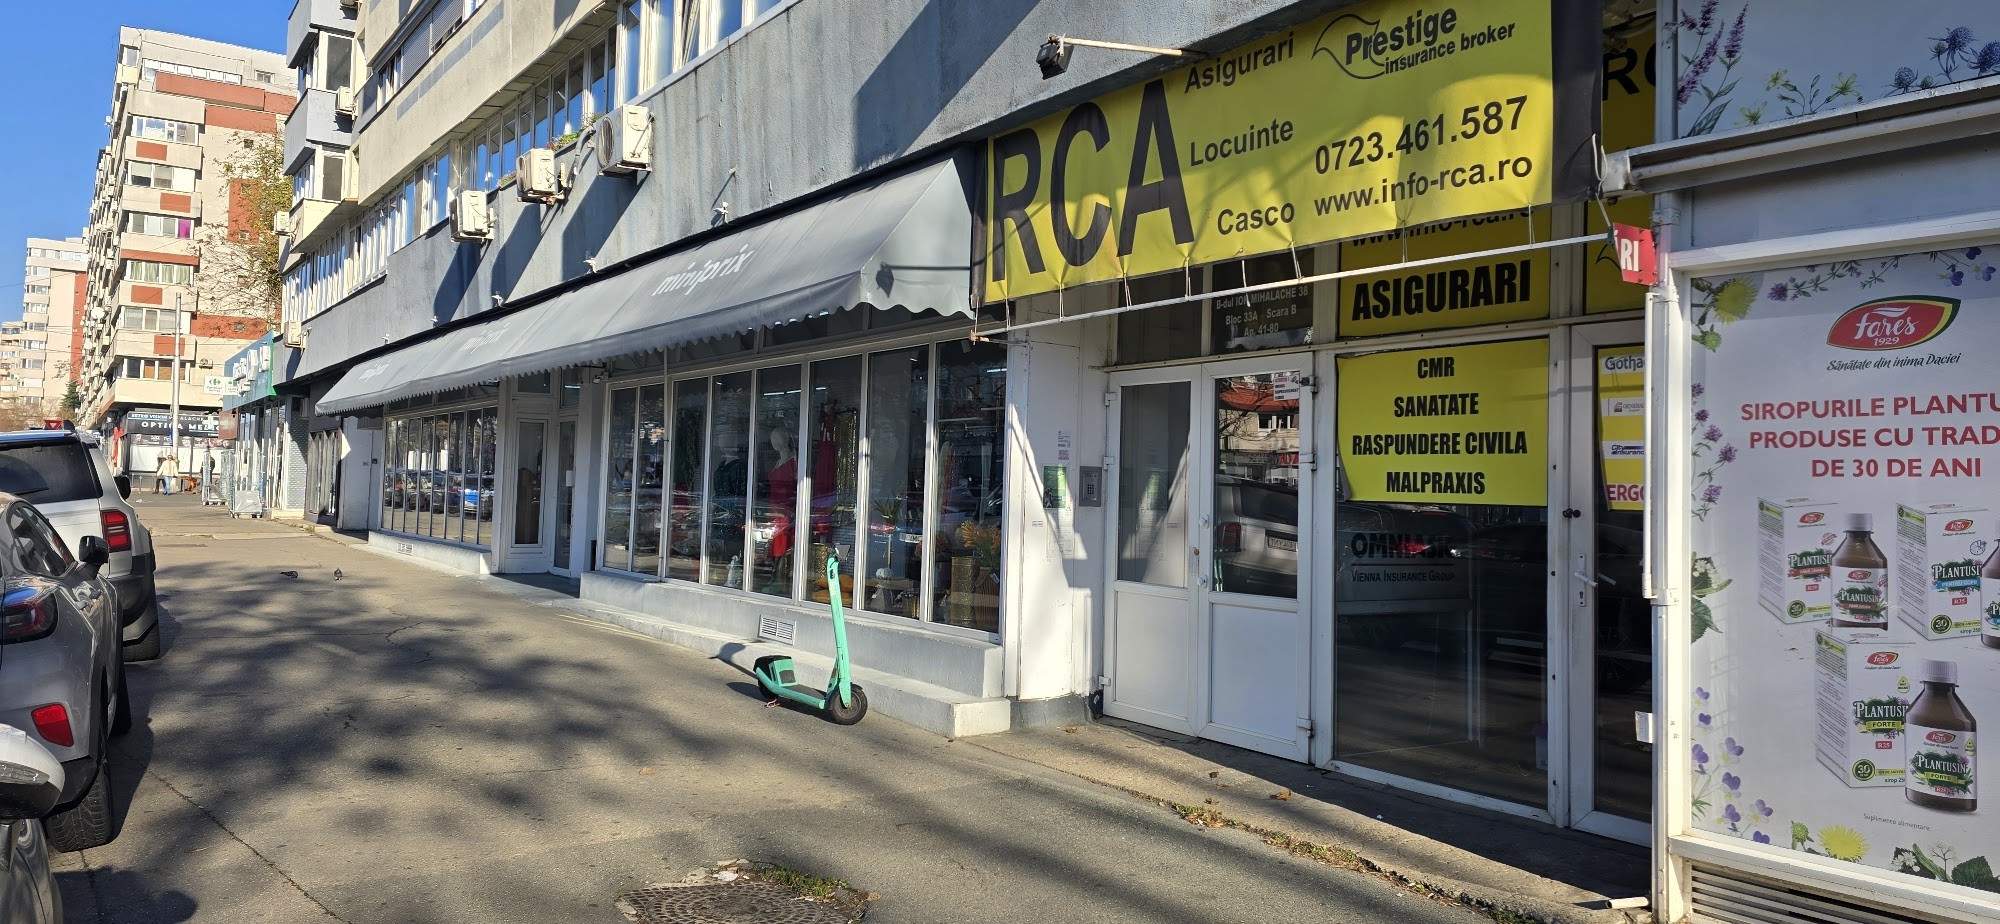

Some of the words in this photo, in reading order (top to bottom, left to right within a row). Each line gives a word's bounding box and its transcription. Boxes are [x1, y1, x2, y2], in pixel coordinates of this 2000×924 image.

[1344, 4, 1458, 65] Prestige
[1385, 43, 1456, 76] insurance
[1459, 20, 1516, 56] broker
[1184, 31, 1296, 94] Asigurari
[1190, 120, 1295, 167] Locuinte
[1314, 95, 1529, 176] 0723.461.587
[991, 79, 1195, 282] RCA
[1314, 155, 1534, 218] www.info-rca.ro
[1217, 201, 1296, 236] Casco
[1614, 230, 1639, 272] RI
[651, 244, 755, 297] miniprix
[1251, 288, 1296, 304] MIHALACHE
[1352, 260, 1531, 321] ASIGURARI
[1225, 315, 1241, 325] Bloc
[1266, 309, 1289, 319] Scara
[1854, 312, 1920, 340] fares
[1873, 337, 1900, 346] 1929
[1417, 357, 1455, 379] CMR
[1604, 355, 1645, 371] Gotha
[1873, 356, 1891, 369] din
[1892, 355, 1924, 368] inima
[1926, 352, 1962, 365] Daciei
[1393, 393, 1480, 418] SANATATE
[1740, 397, 1884, 421] SIROPURILE
[1893, 392, 2000, 416] PLANTU
[1351, 433, 1460, 456] RASPUNDERE
[1463, 431, 1528, 455] CIVILA
[1750, 428, 1866, 450] PRODUSE
[1874, 427, 1914, 447] CU
[1922, 425, 2000, 447] TRAD
[1811, 459, 1845, 478] DE
[1852, 459, 1879, 478] 30
[1887, 458, 1922, 478] DE
[1930, 457, 1982, 478] ANI
[1386, 471, 1487, 495] MALPRAXIS
[1606, 484, 1645, 502] ERG
[1788, 552, 1832, 568] PLANTUSI
[1931, 563, 1983, 580] PLANTUSI
[1351, 567, 1381, 583] VIENNA
[1872, 721, 1896, 729] FORTE
[1916, 754, 1969, 775] PLANTUSIN
[1885, 777, 1898, 786] sirop
